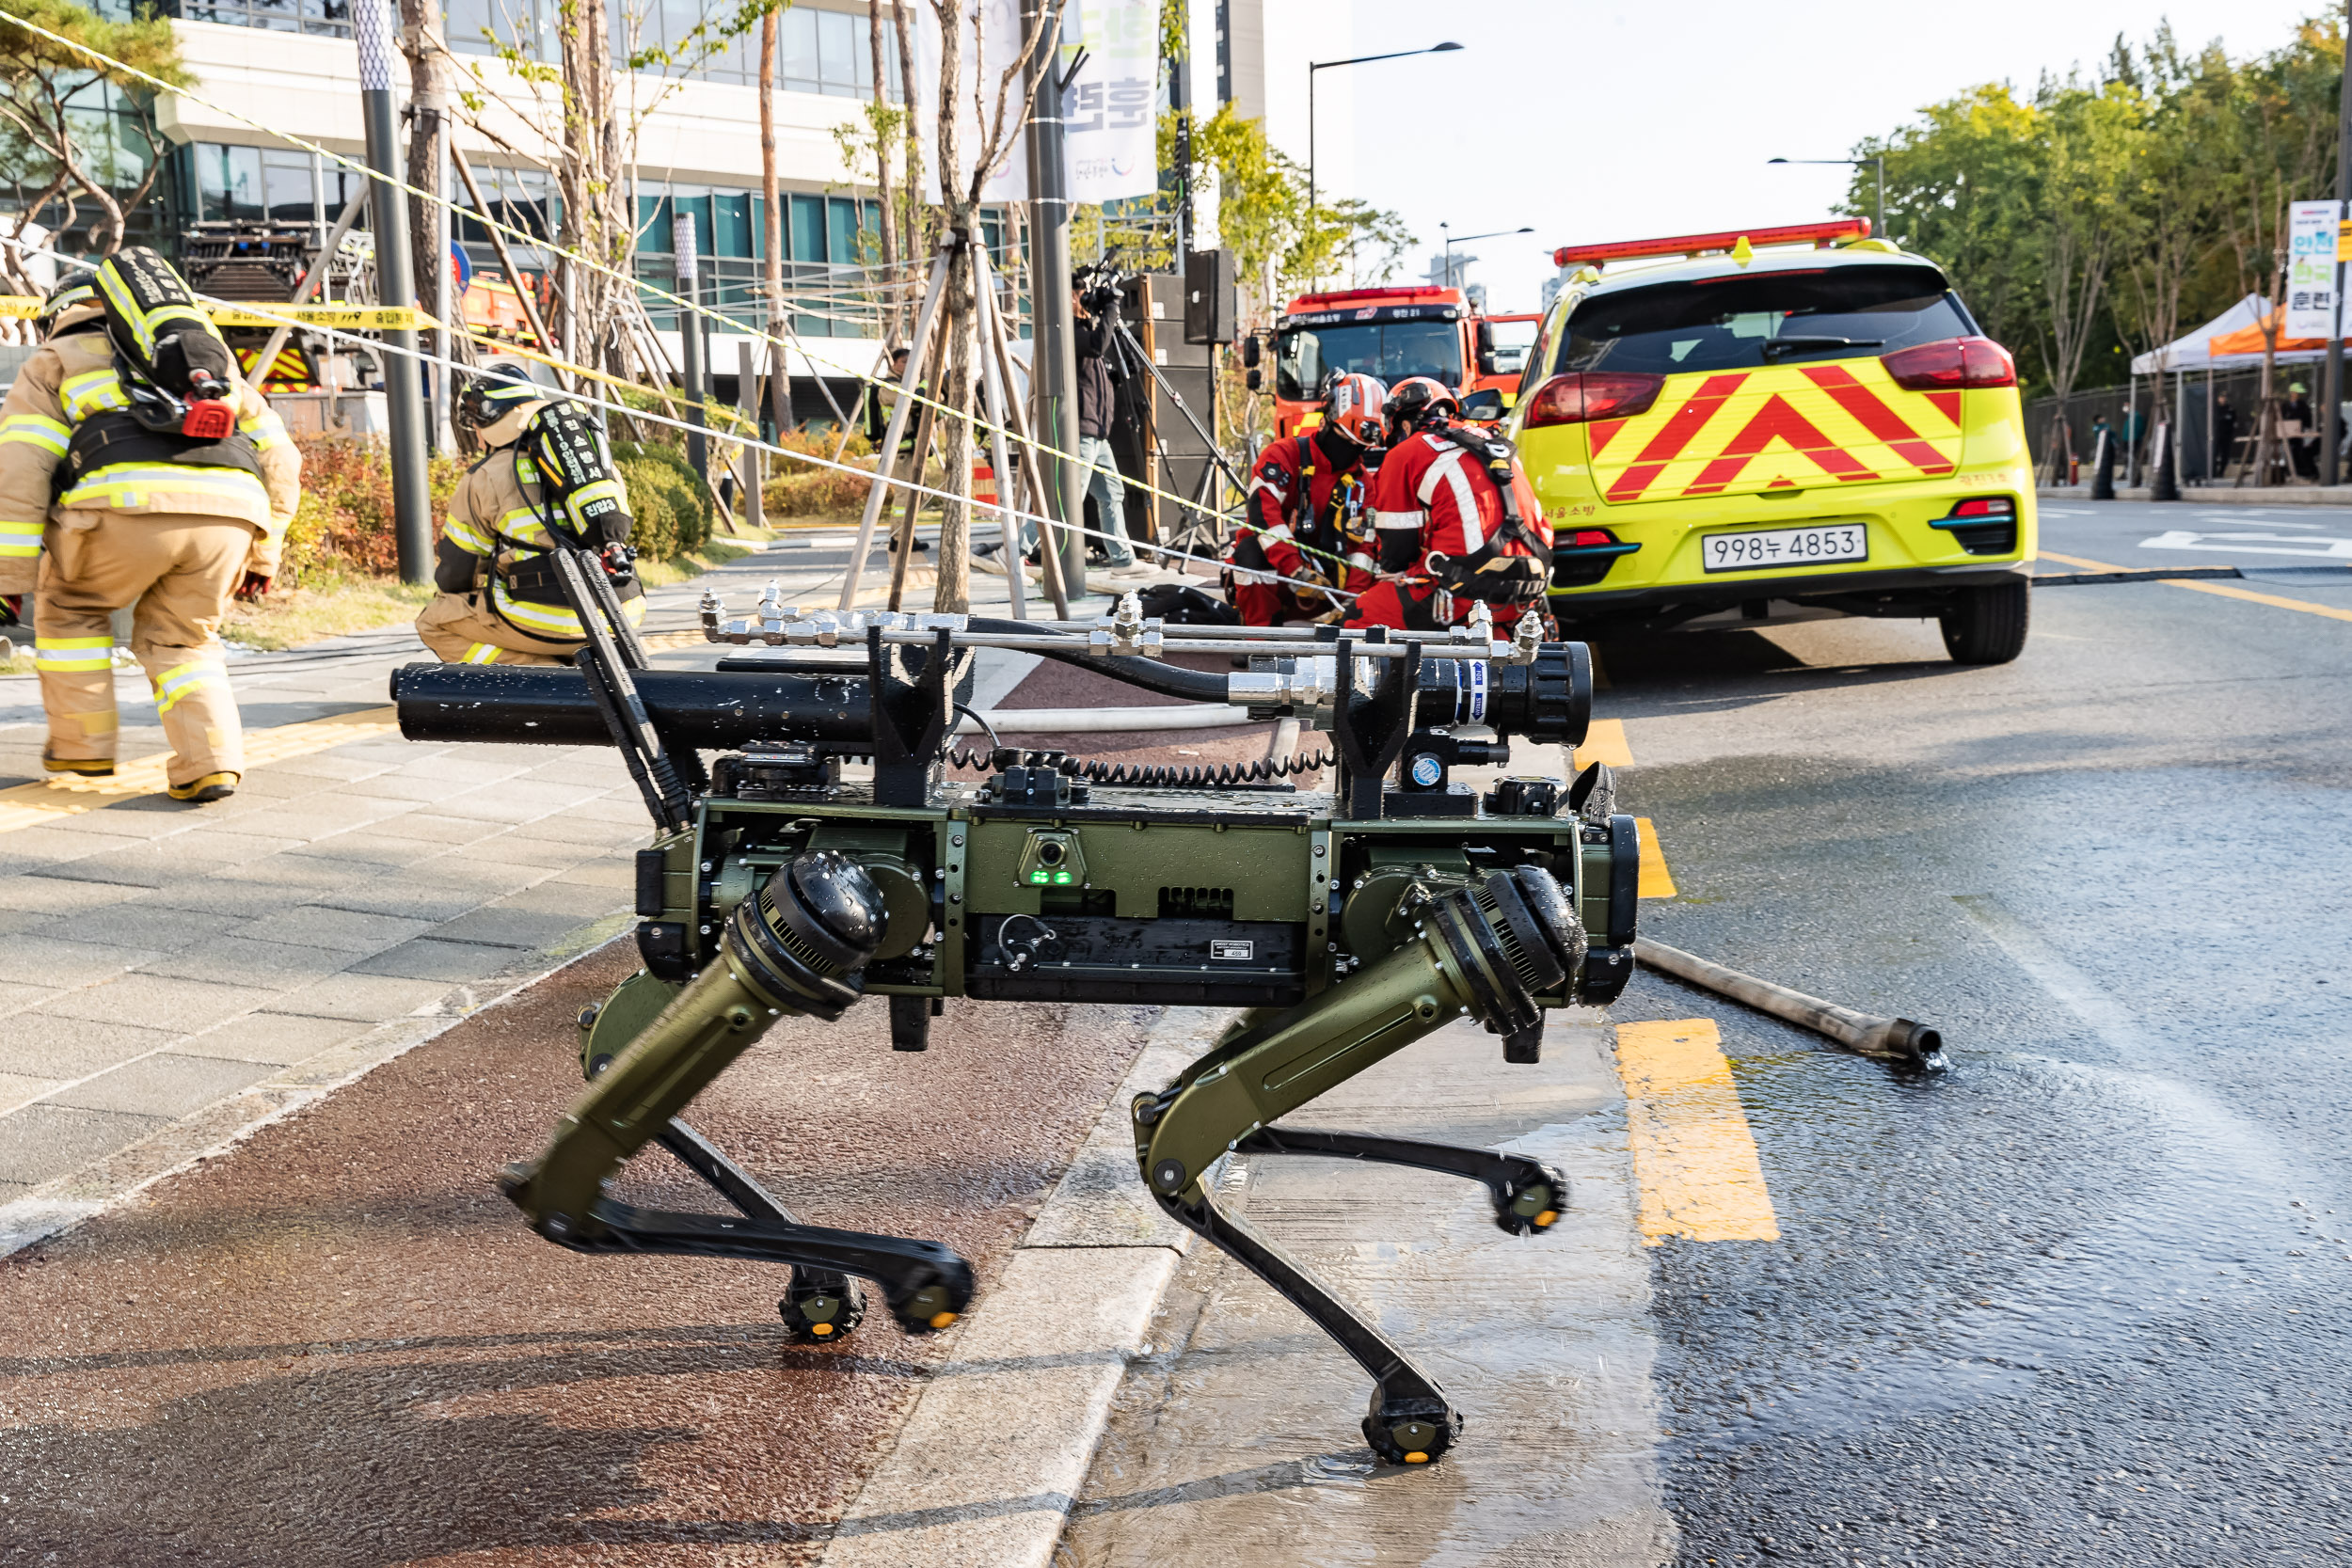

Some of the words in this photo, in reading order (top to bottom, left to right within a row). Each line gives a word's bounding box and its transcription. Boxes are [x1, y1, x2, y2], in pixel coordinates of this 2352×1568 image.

[2294, 231, 2333, 255] 안전
[2293, 262, 2332, 285] 한국
[2292, 292, 2330, 310] 훈련
[555, 403, 603, 480] 광진소방서
[584, 499, 616, 517] 진압3
[1544, 505, 1596, 518] 서울소방
[1714, 537, 1782, 563] 998누
[1788, 531, 1854, 557] 4853
